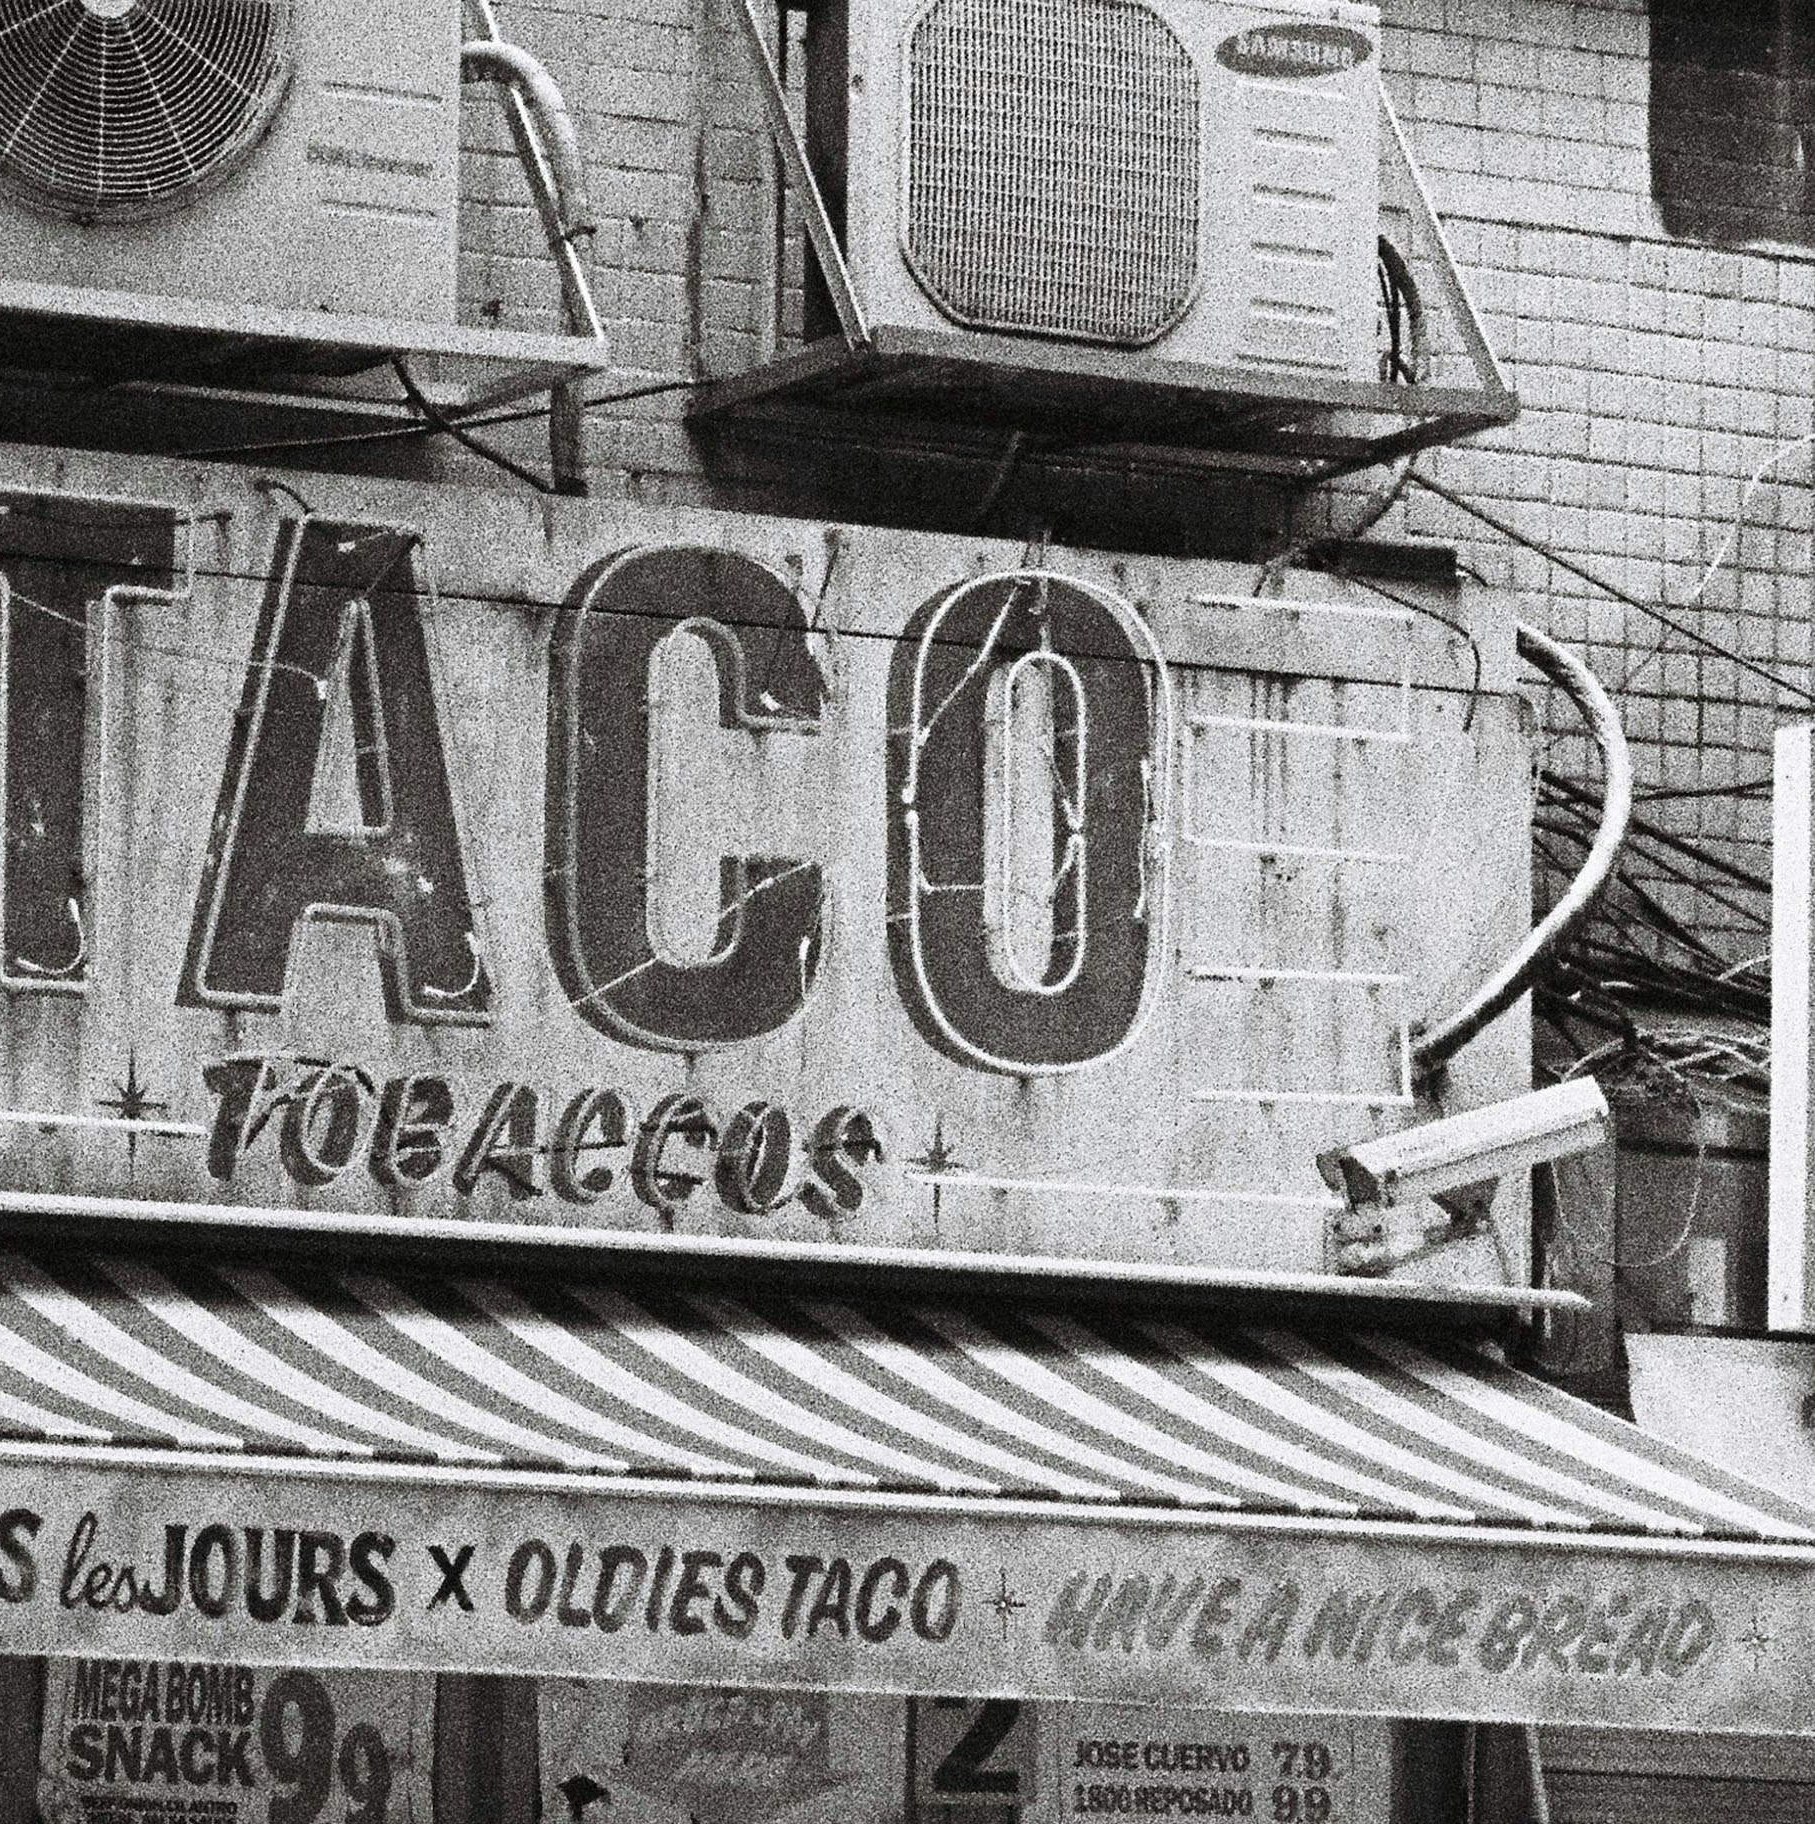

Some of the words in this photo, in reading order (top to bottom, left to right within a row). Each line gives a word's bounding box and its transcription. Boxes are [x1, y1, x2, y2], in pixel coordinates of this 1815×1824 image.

[1237, 31, 1353, 70] SAMSUNG
[203, 1048, 883, 1224] TOBACCOS
[59, 1508, 139, 1616] les
[139, 1522, 398, 1629] JOURS
[427, 1544, 476, 1613] X
[503, 1536, 765, 1641] OLDIES
[776, 1554, 964, 1647] TACO
[1043, 1568, 1243, 1656] HAVE
[1237, 1580, 1302, 1664] A
[1300, 1584, 1490, 1671] NICE
[1477, 1588, 1719, 1681] BREAD
[72, 1661, 160, 1722] MEGA
[168, 1662, 254, 1725] BOMB
[69, 1724, 255, 1788] SNACK
[1073, 1740, 1139, 1770] JOSE
[1142, 1741, 1252, 1773] CUERVO
[1073, 1784, 1137, 1814] 1800
[1135, 1785, 1254, 1817] REPOSADO
